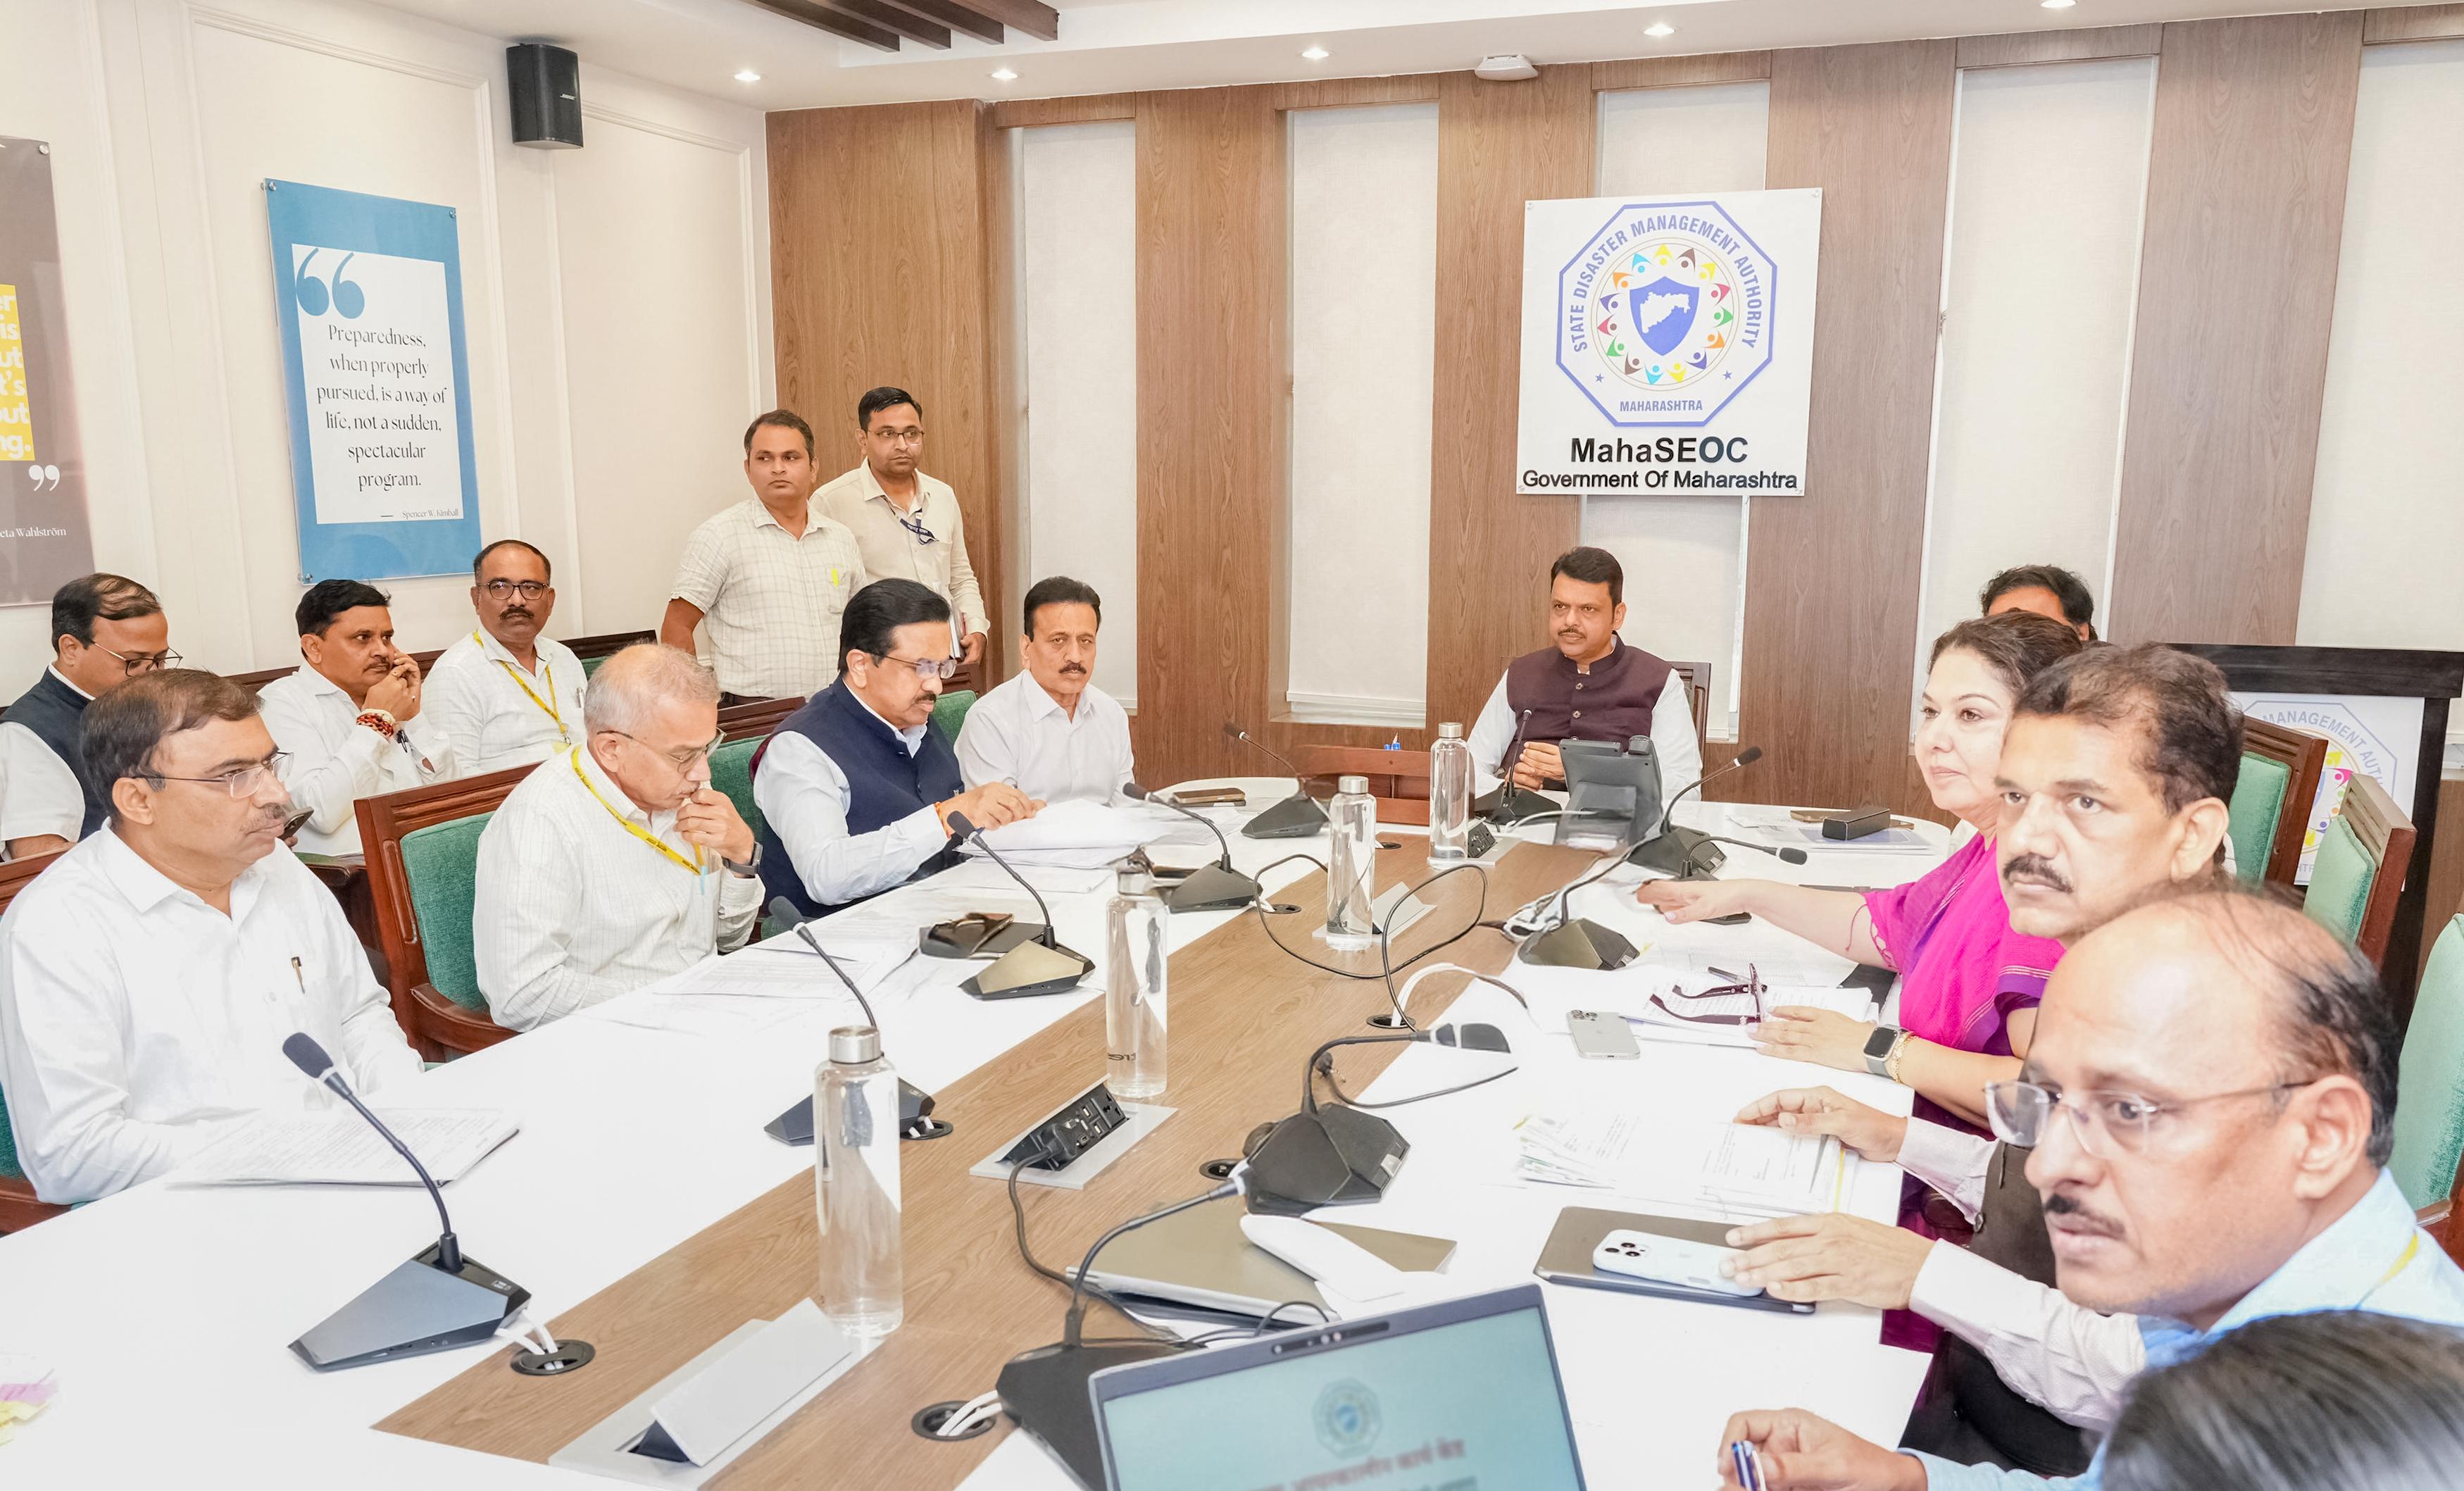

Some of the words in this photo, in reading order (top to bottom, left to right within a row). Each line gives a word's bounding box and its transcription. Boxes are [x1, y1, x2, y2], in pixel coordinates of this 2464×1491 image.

[1630, 215, 1740, 256] MANAGEMENT
[1573, 230, 1628, 299] DISASTER
[1734, 255, 1762, 349] AUTHORITY
[329, 325, 426, 348] Preparedness,
[1570, 304, 1588, 352] STATE
[330, 353, 368, 372] when
[371, 358, 429, 379] properly
[317, 384, 379, 404] pursued,
[381, 387, 392, 402] is
[395, 390, 403, 402] a
[404, 390, 430, 406] way
[432, 387, 447, 404] of
[1620, 399, 1703, 412] MAHARASHTRA
[326, 411, 351, 430] life,
[354, 416, 377, 430] not
[380, 418, 389, 430] a
[392, 413, 442, 432] sudden,
[348, 442, 426, 463] spectacular
[1570, 435, 1749, 463] MahaSEOC
[358, 473, 422, 492] program.
[1522, 469, 1638, 489] Government
[1644, 470, 1668, 488] Of
[1673, 470, 1797, 489] Maharashtra
[402, 511, 427, 520] Spencer
